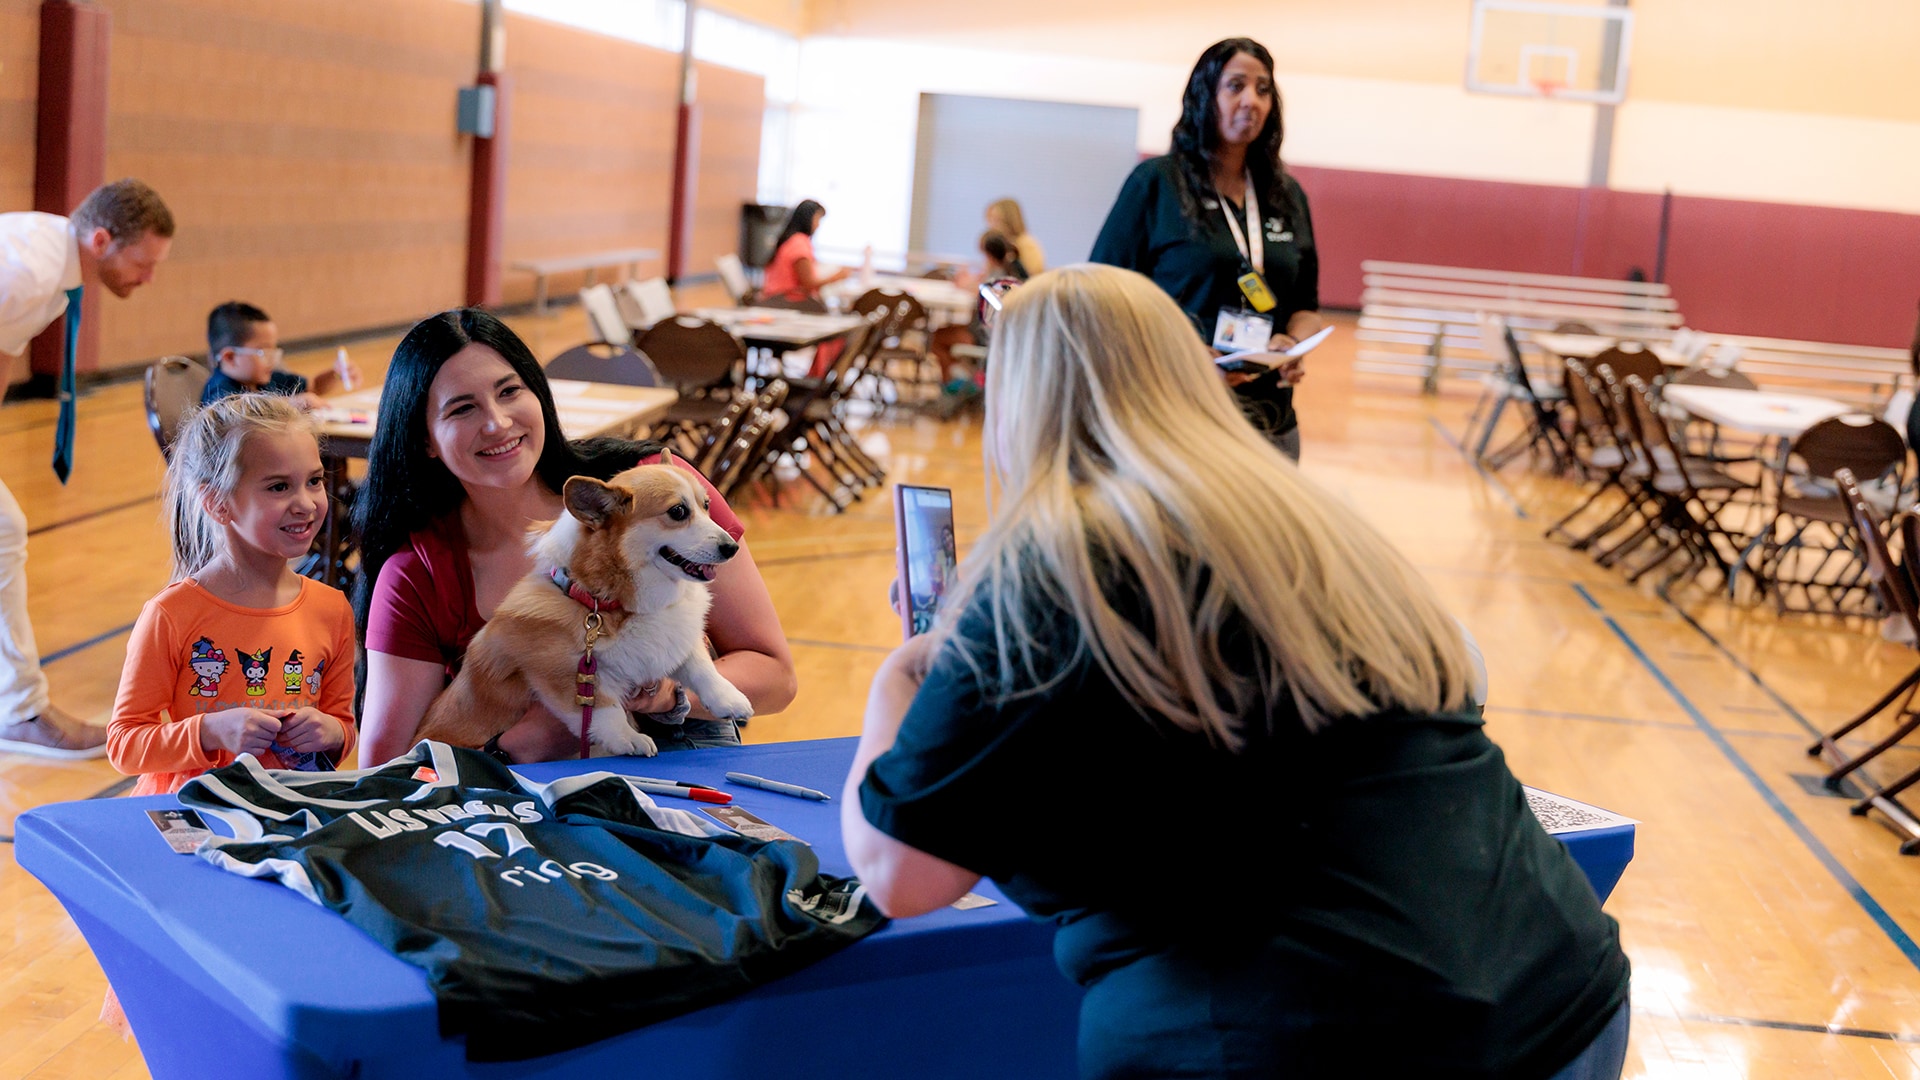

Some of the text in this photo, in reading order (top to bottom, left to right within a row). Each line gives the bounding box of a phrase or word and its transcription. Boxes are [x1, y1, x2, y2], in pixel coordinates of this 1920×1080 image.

[347, 800, 543, 840] LAS VEGAS
[433, 822, 535, 859] 17
[500, 859, 618, 887] ring
